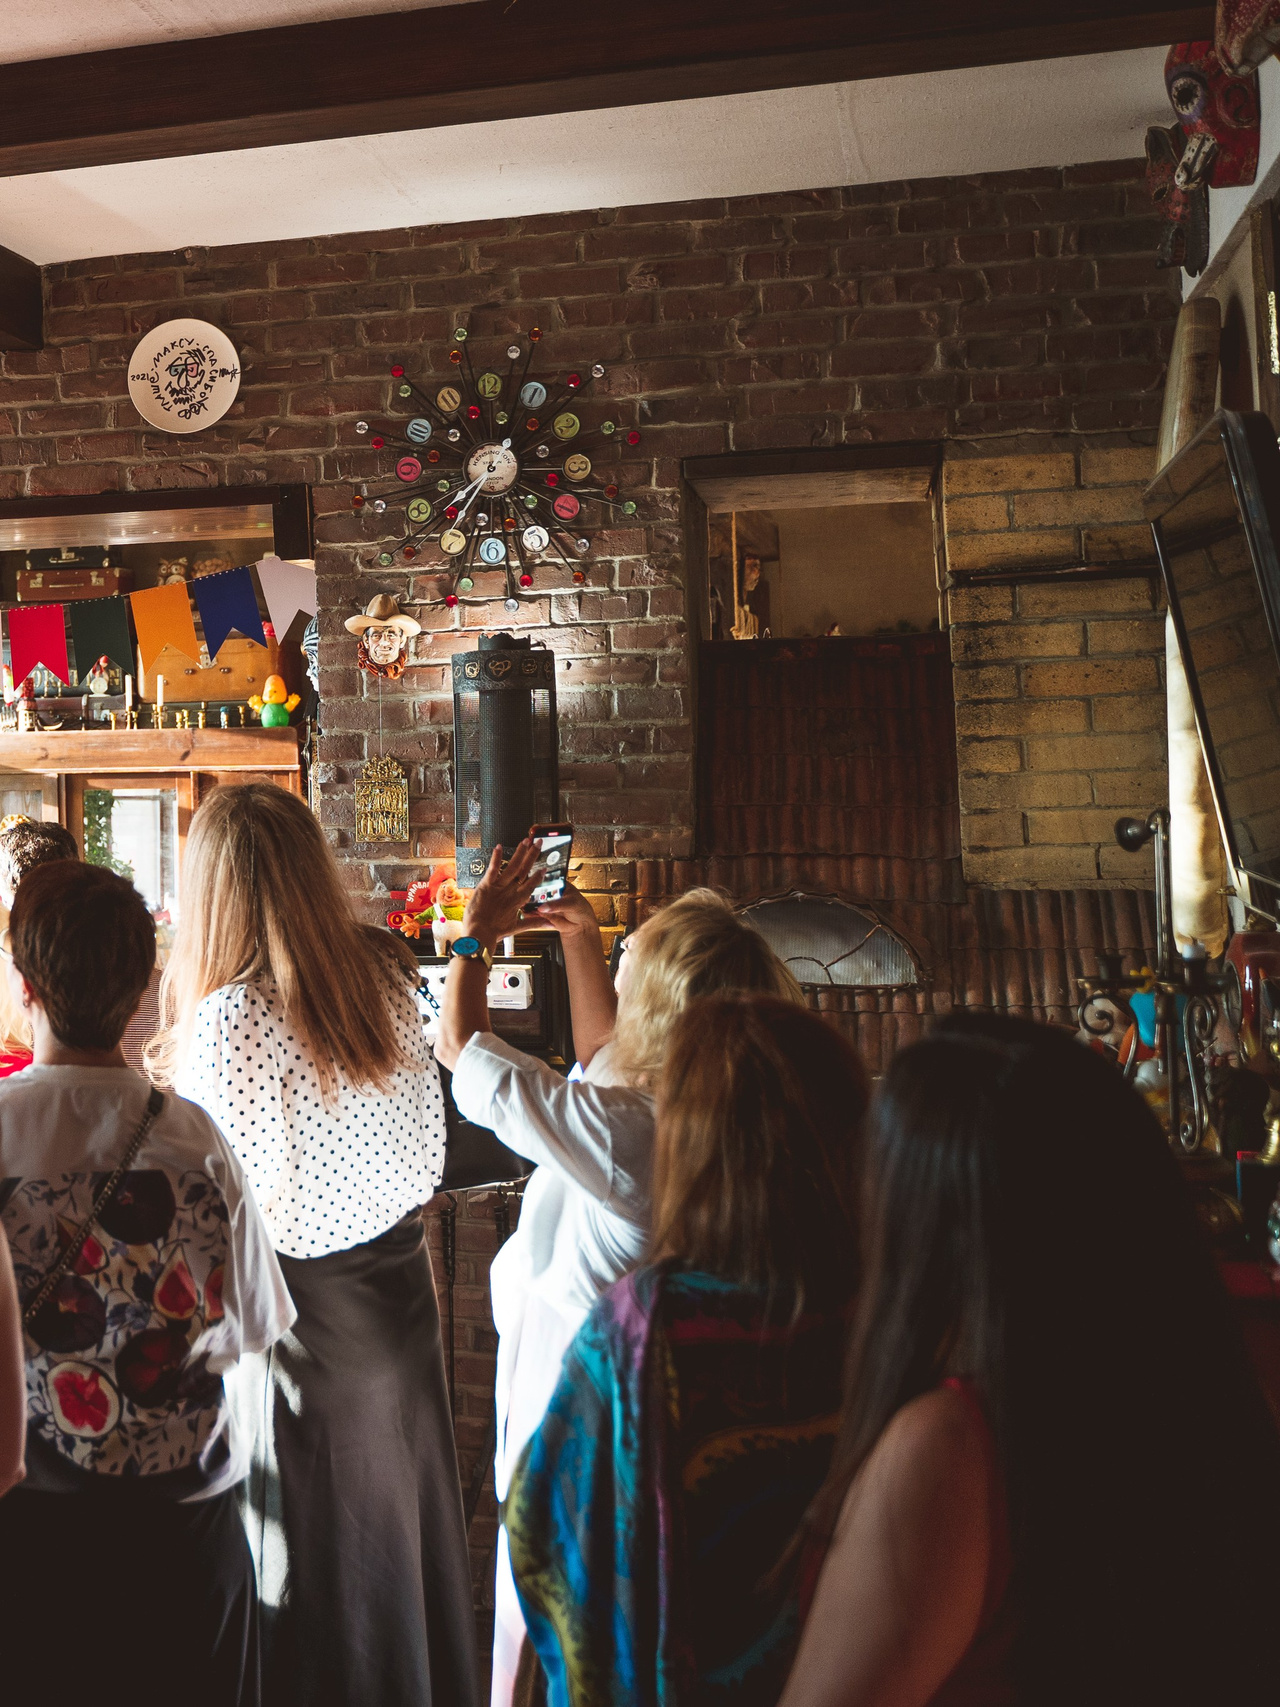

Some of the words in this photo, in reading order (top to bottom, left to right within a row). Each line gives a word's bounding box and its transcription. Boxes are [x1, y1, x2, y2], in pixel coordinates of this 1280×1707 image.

[153, 338, 195, 367] МАКСУ
[130, 373, 150, 381] 2021
[482, 377, 498, 395] 12
[441, 391, 458, 408] 11
[528, 387, 539, 404] 1
[409, 422, 429, 440] 10
[557, 418, 575, 432] 2
[472, 449, 512, 467] KENSINGON
[568, 461, 586, 474] 3
[410, 503, 429, 519] 8
[556, 498, 575, 514] 4
[448, 532, 460, 550] 7
[527, 529, 543, 547] 5
[486, 541, 499, 560] 6
